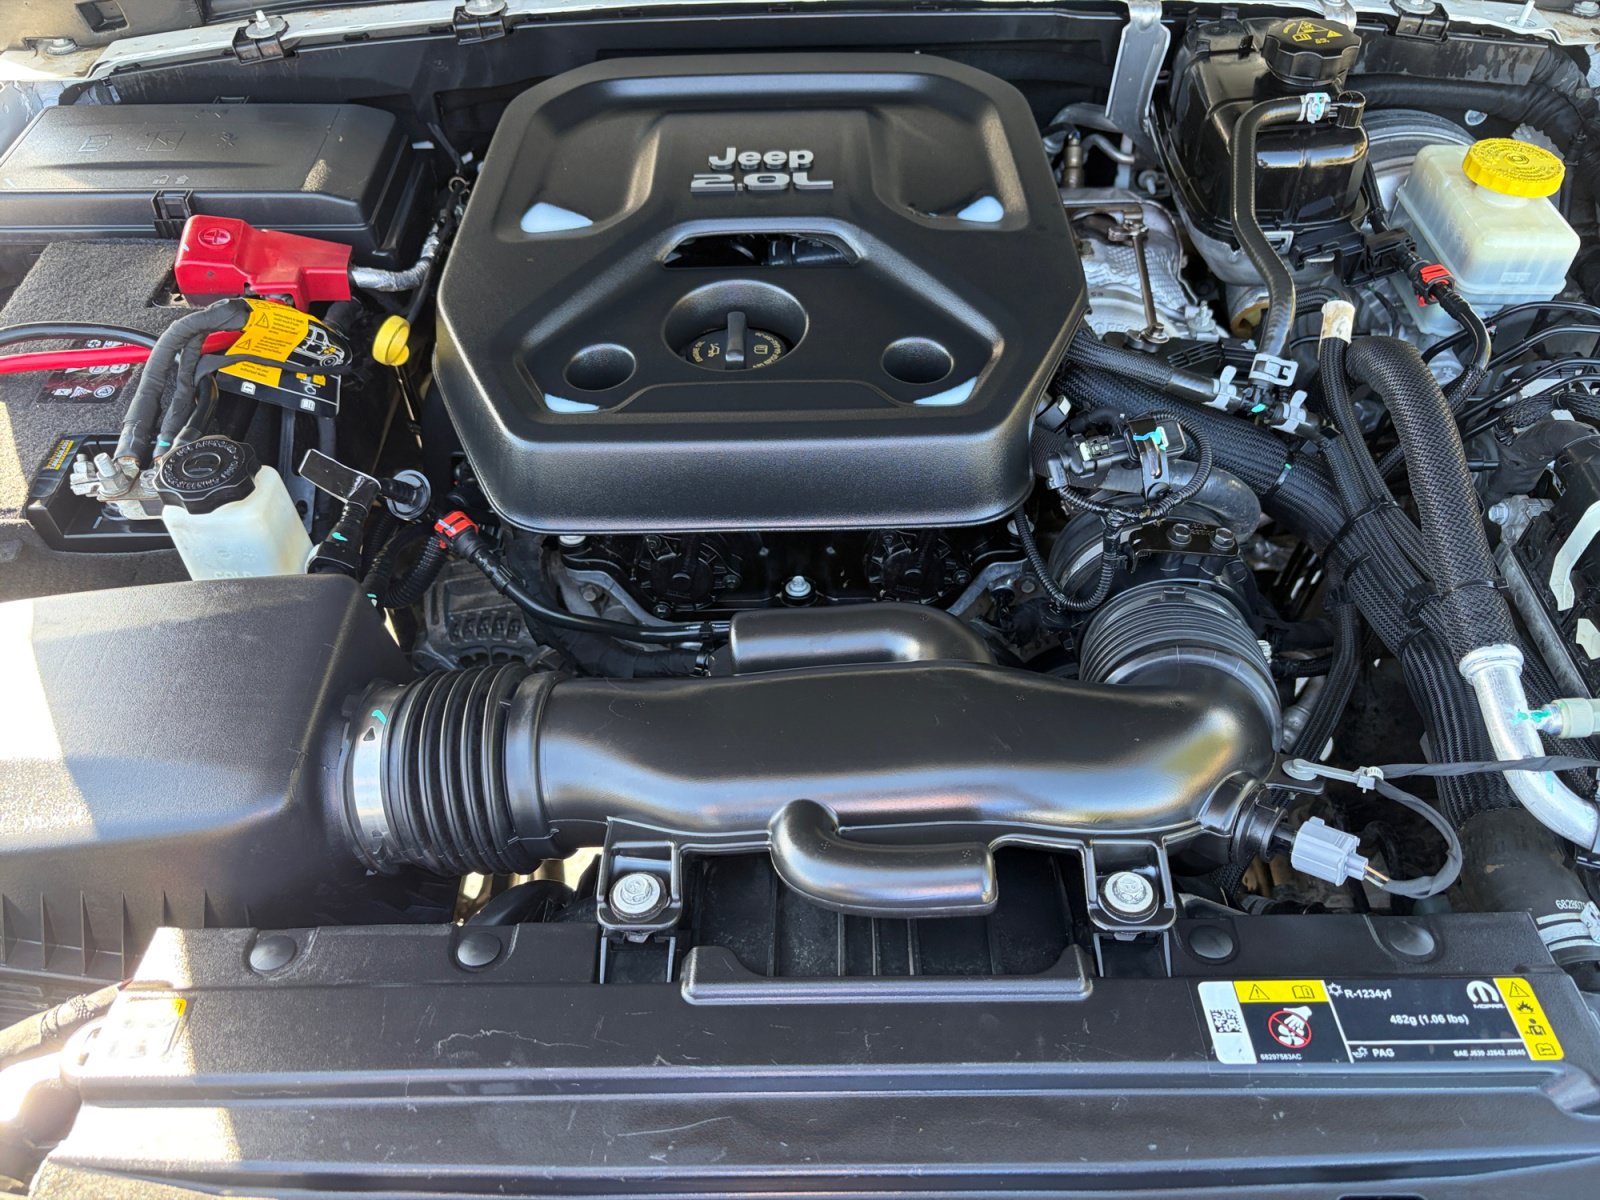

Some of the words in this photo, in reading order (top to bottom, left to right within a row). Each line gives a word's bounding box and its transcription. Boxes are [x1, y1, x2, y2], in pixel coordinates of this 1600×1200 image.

[708, 147, 814, 171] Jeep
[690, 171, 834, 192] 2.0L
[1343, 989, 1393, 1001] R-1234yf
[1390, 1014, 1417, 1026] 482g
[1419, 1014, 1446, 1026] (1.06
[1447, 1014, 1470, 1026] lbs)
[1372, 1048, 1395, 1058] PAG
